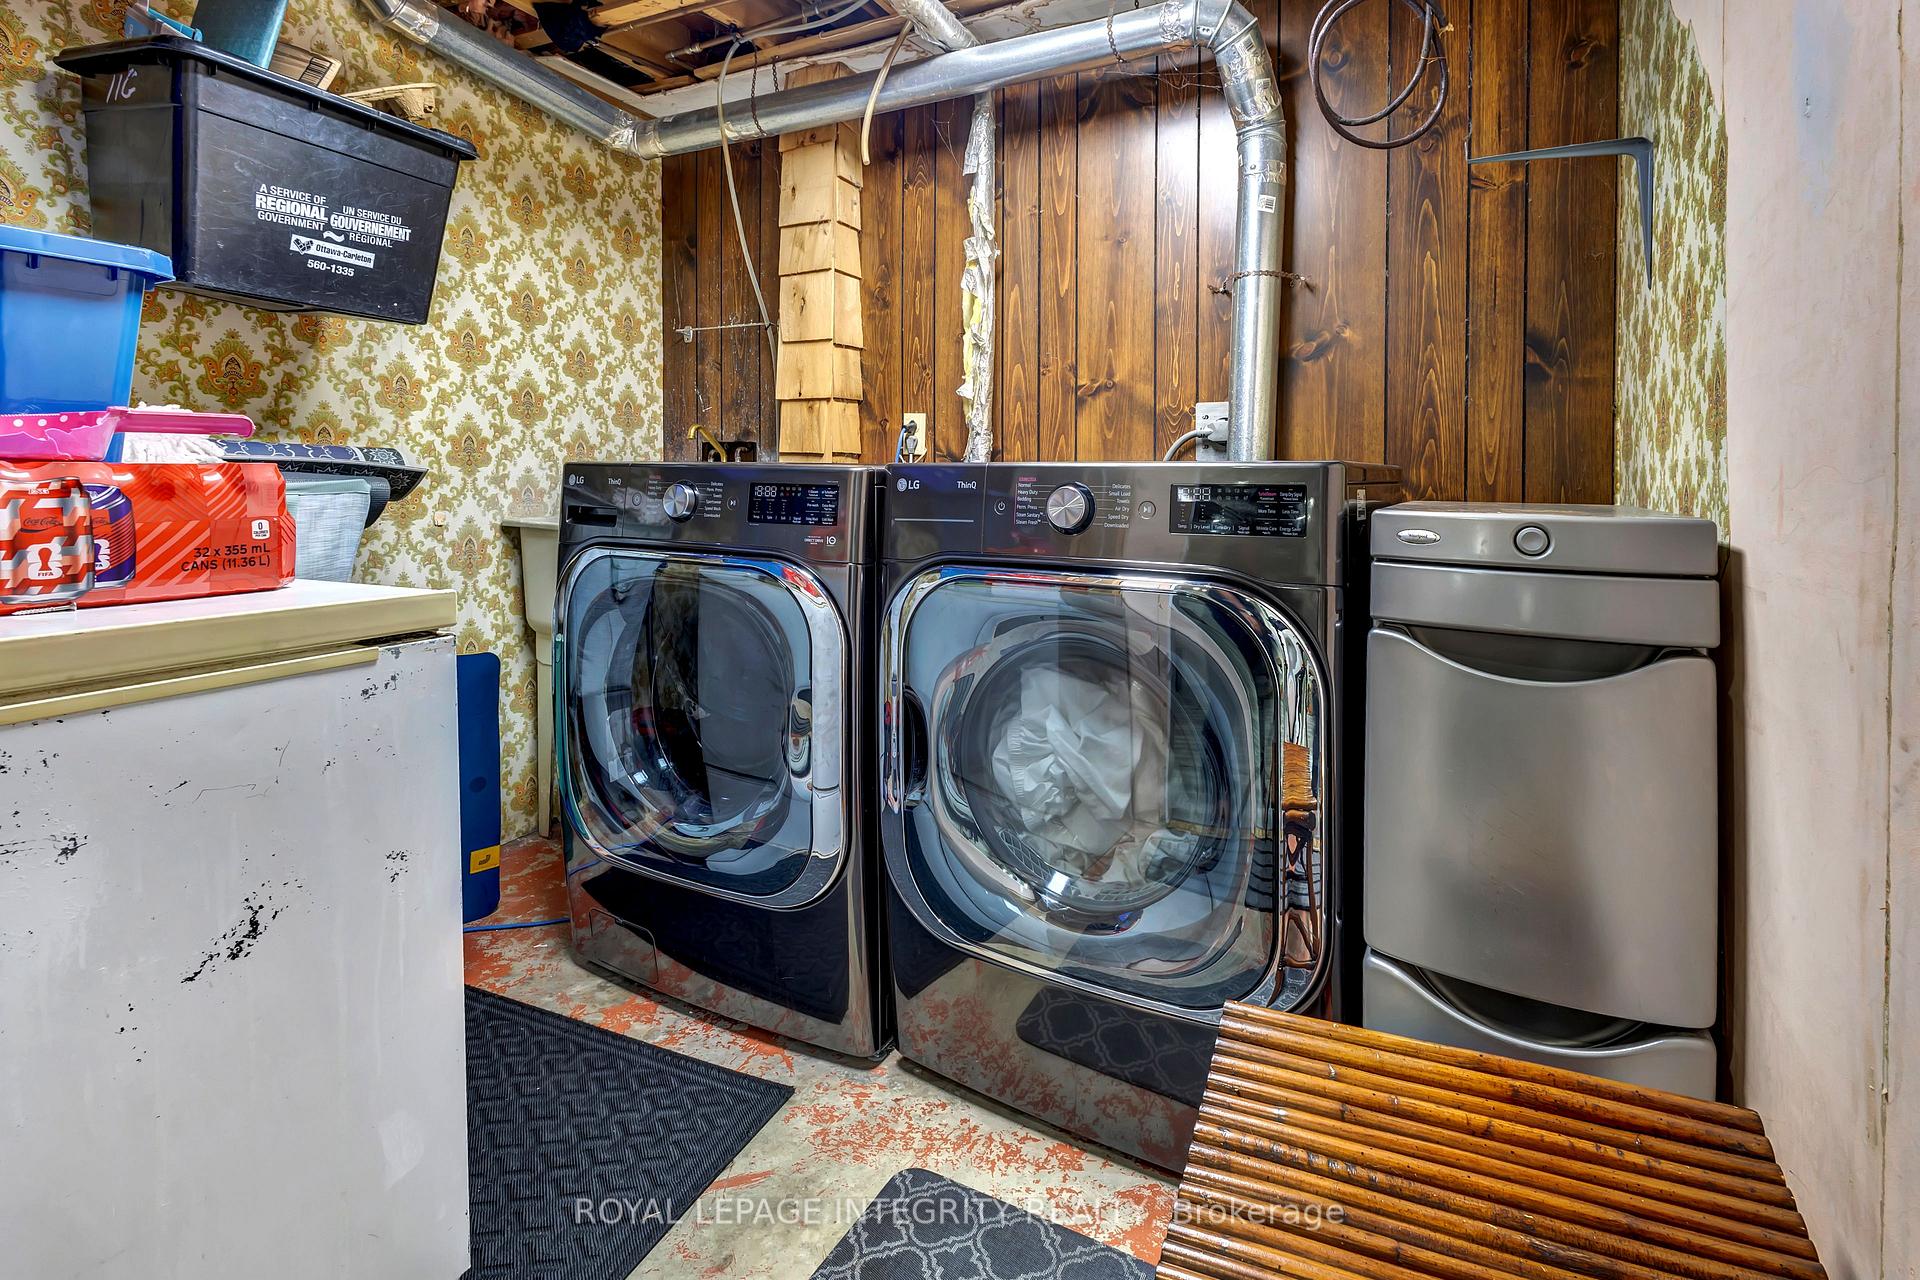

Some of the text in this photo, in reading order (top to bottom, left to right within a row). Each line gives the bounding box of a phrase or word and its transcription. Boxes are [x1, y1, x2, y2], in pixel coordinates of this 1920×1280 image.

[259, 183, 326, 205] A SERVICE OF
[255, 194, 328, 221] REGIONAL
[342, 206, 402, 225] UN SERVICE DU
[257, 211, 326, 231] GOVERNMENT
[330, 214, 412, 241] GOUVERNEMENT
[315, 244, 372, 264] Ottawa-Carleton
[307, 259, 355, 277] 560-1335
[608, 478, 622, 486] ThinQ
[956, 481, 977, 490] ThinQ
[194, 547, 209, 558] 32
[225, 545, 247, 556] 355
[252, 543, 270, 553] mL
[181, 555, 270, 571] CANS (11.36 L)
